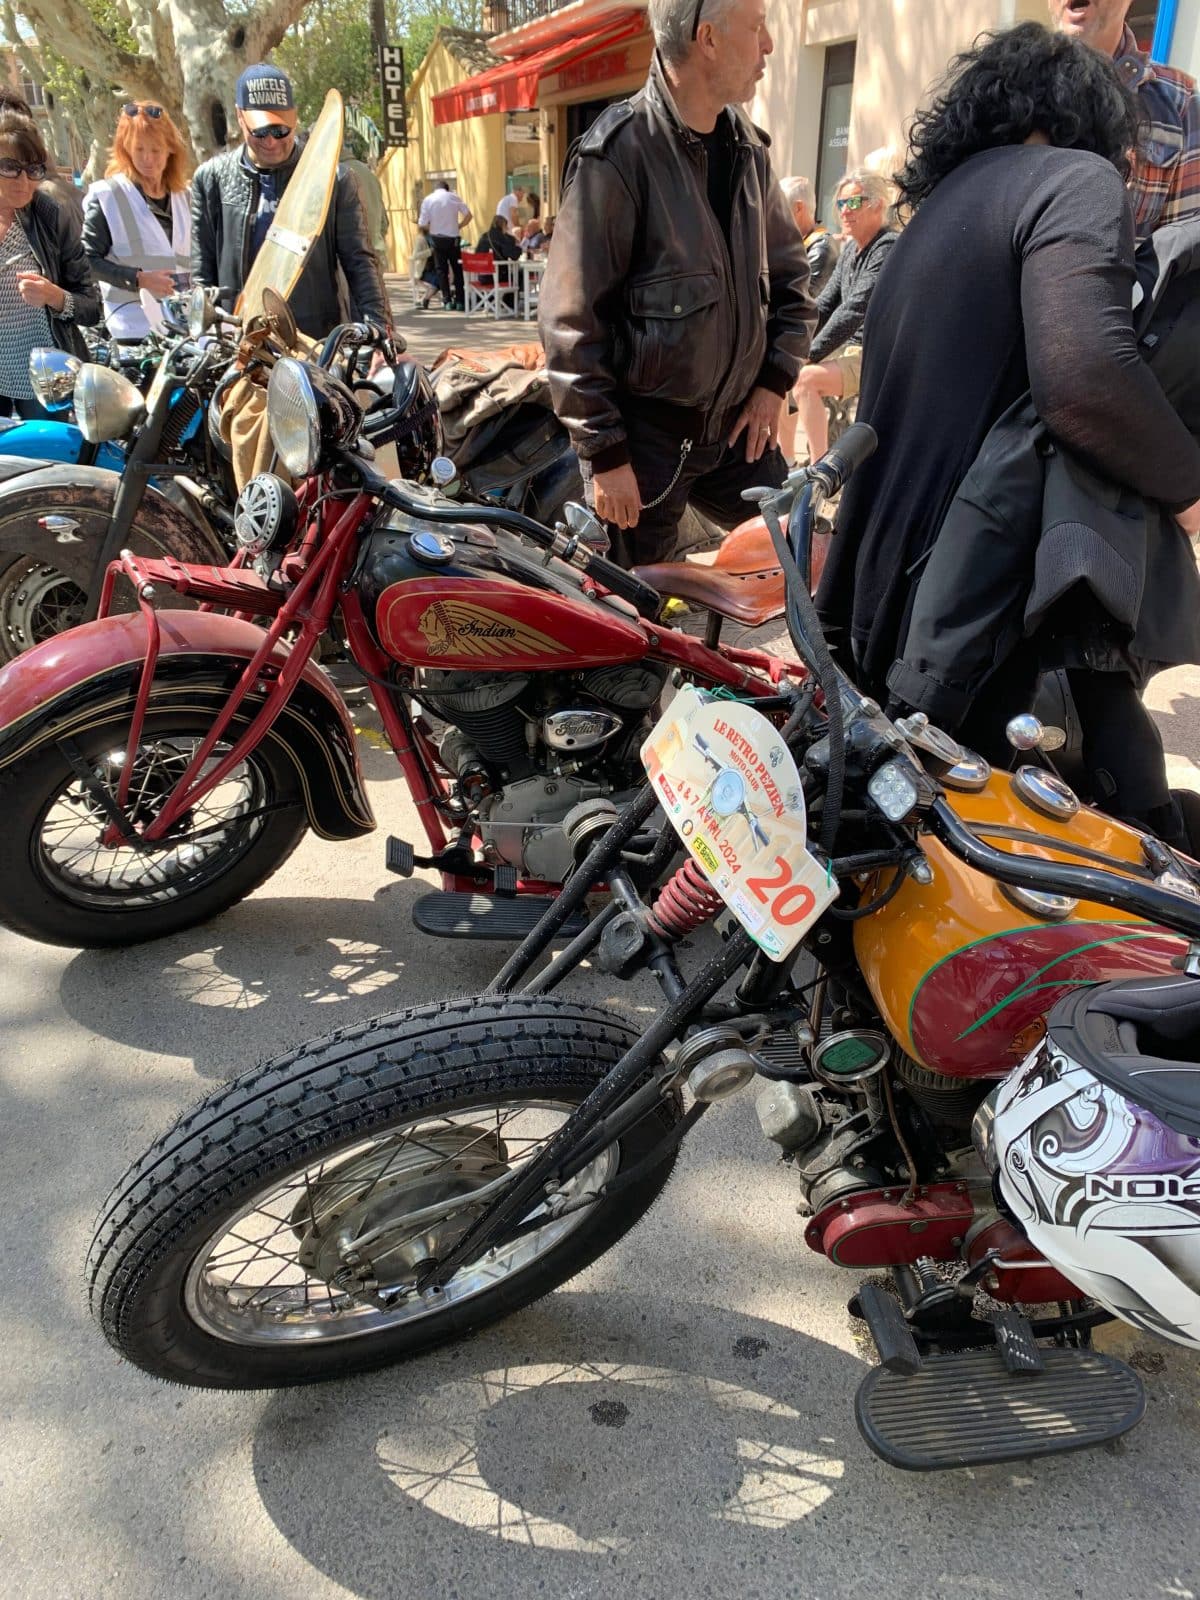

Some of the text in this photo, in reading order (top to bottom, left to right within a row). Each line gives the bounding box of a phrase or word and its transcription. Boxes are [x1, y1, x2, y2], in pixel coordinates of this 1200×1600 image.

[246, 78, 286, 92] WHEELS
[383, 47, 404, 137] HOTEL
[458, 619, 516, 638] Indian
[555, 720, 602, 737] Indian
[713, 719, 785, 818] LE RETRO PEZIEN
[729, 750, 760, 792] MOTO CLUB
[677, 781, 742, 874] 6 & 7 AVRIL 2024
[746, 855, 816, 926] 20
